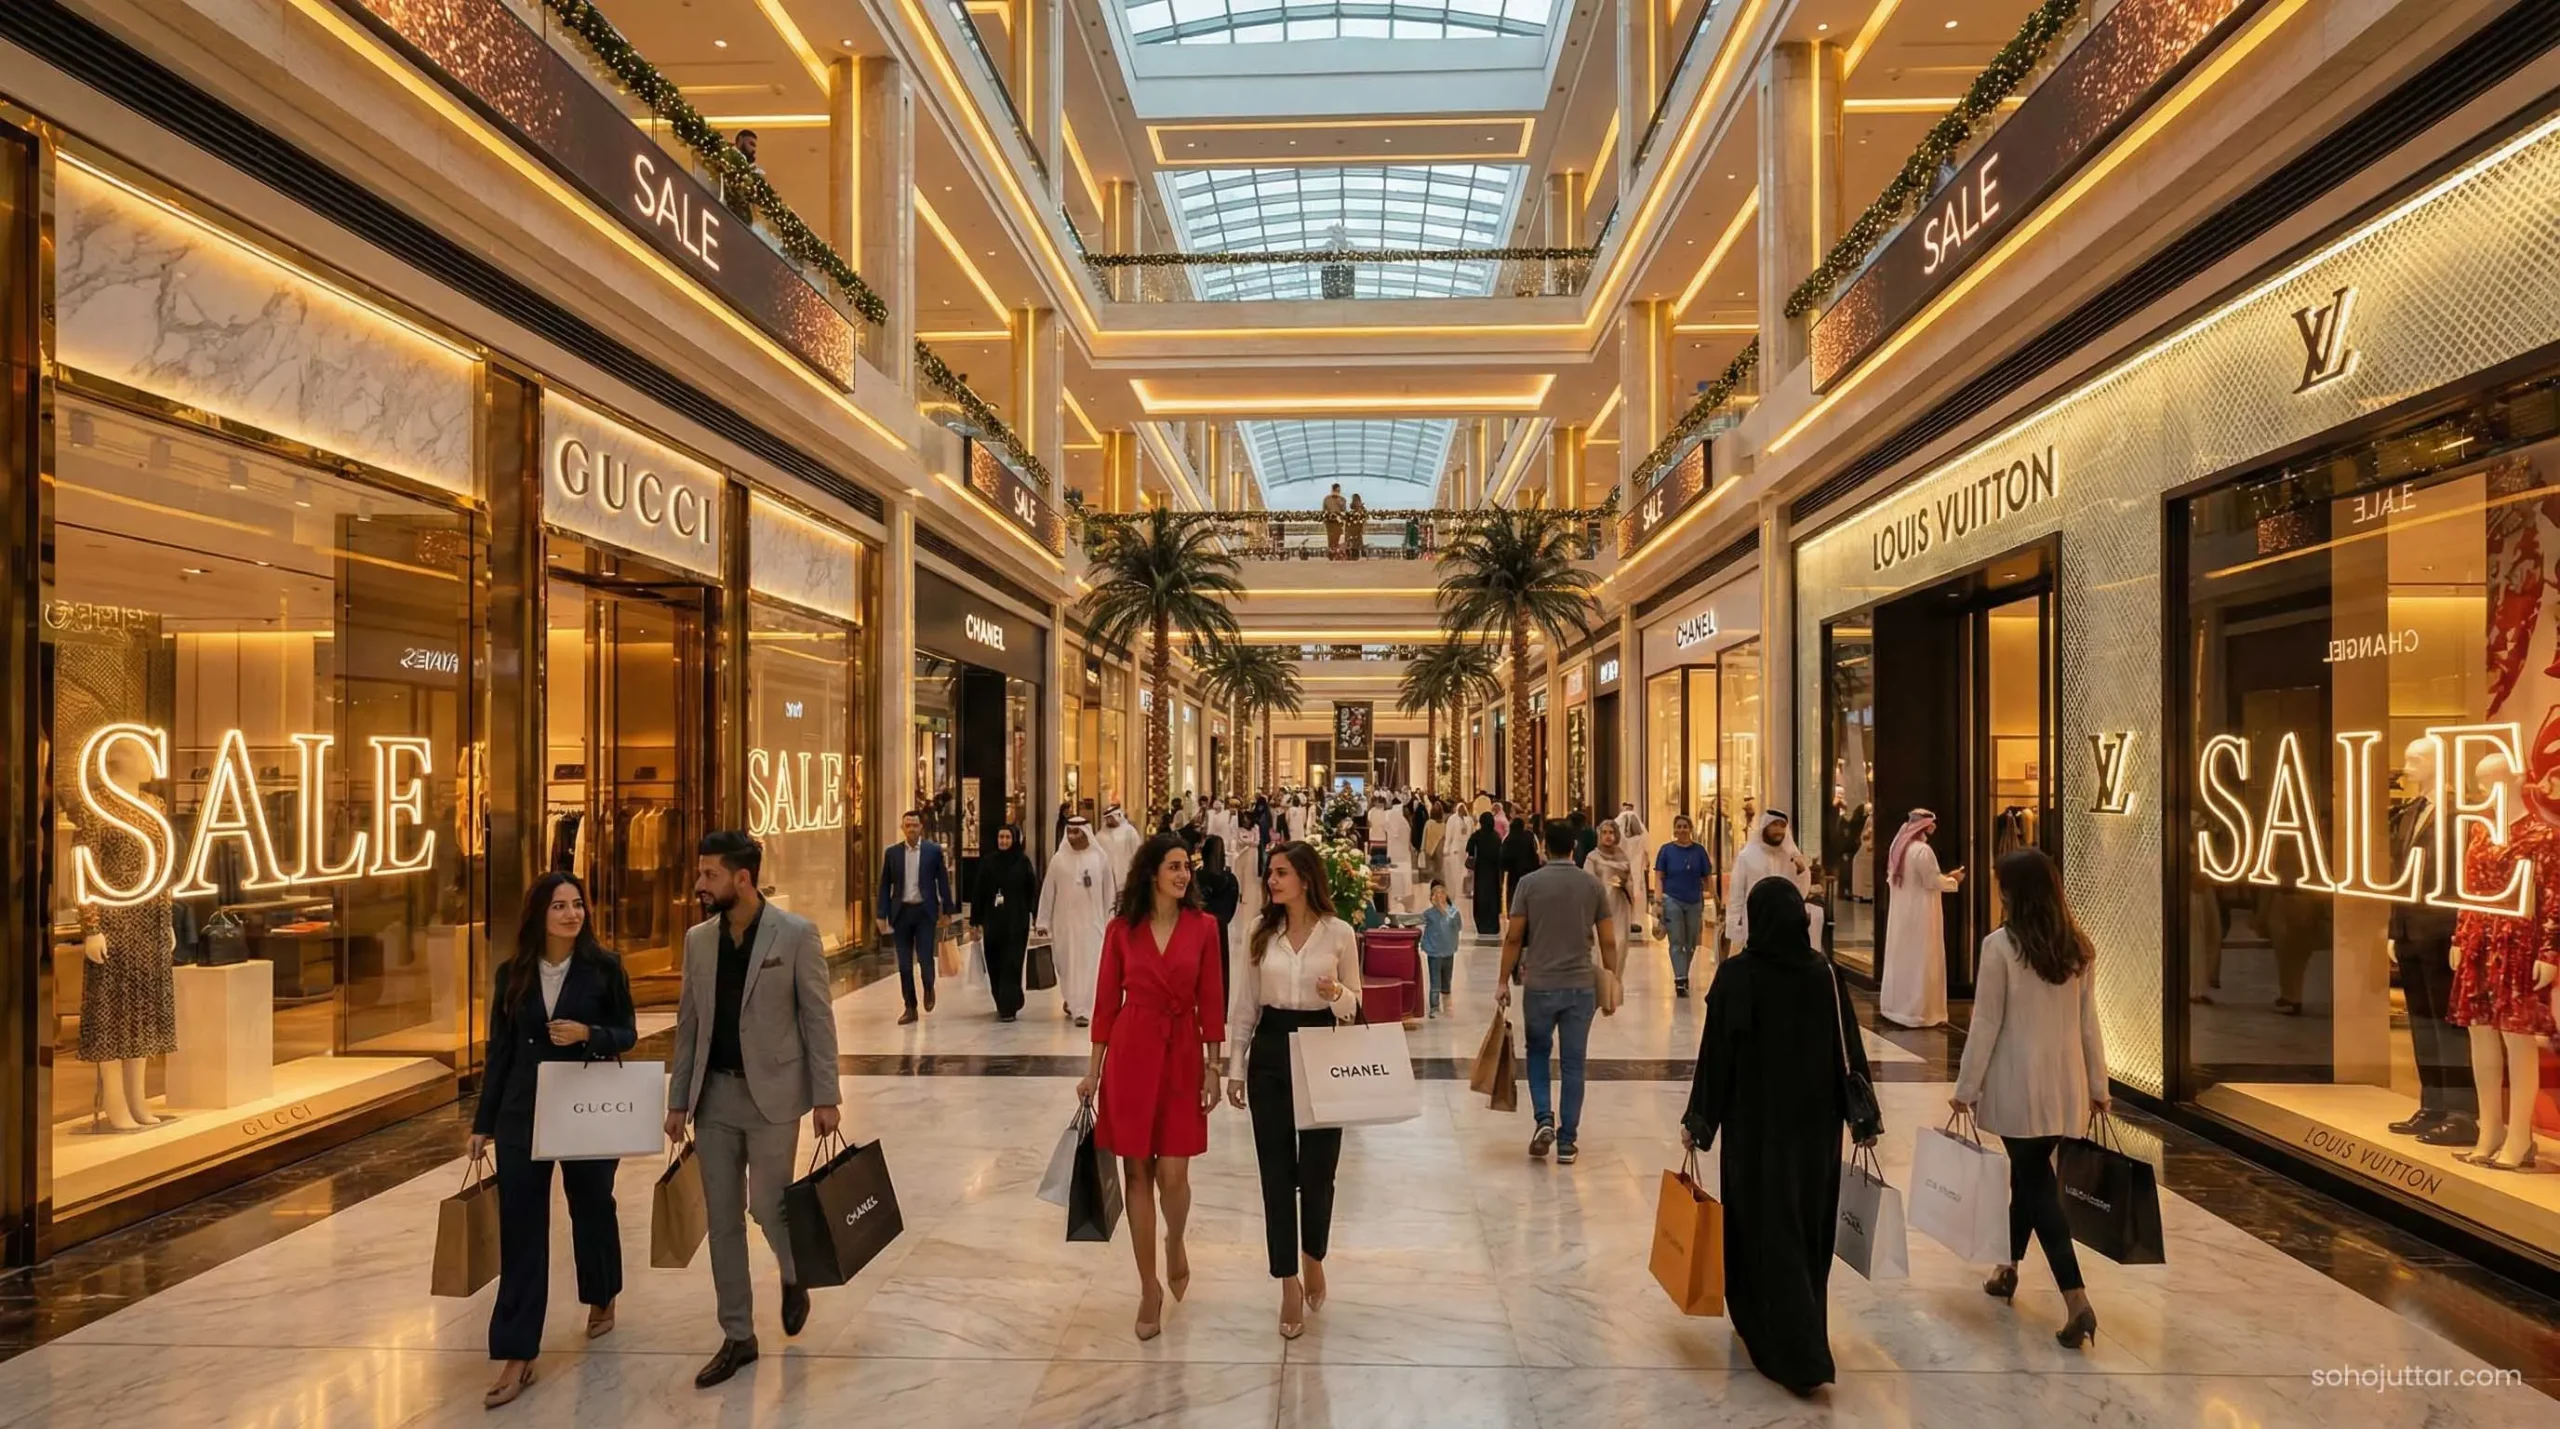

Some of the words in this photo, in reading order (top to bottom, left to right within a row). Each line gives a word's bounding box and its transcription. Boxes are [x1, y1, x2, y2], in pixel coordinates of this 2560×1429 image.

[633, 154, 721, 272] SALE
[1923, 152, 2000, 275] SALE
[556, 438, 712, 545] GUCCI
[1872, 508, 1931, 571] LOUIS
[1936, 446, 2059, 542] VUITTON
[965, 613, 1006, 651] CHANEL
[1676, 610, 1716, 648] CHANEL
[72, 722, 436, 906] SALE
[747, 748, 843, 837] SALE
[2197, 722, 2532, 915] SALE
[573, 1102, 634, 1114] GUCCI
[1331, 1065, 1390, 1079] CHANEL
[242, 1103, 312, 1136] GUCCI
[2304, 1126, 2355, 1158] LOUIS
[2360, 1147, 2442, 1195] VUITTON
